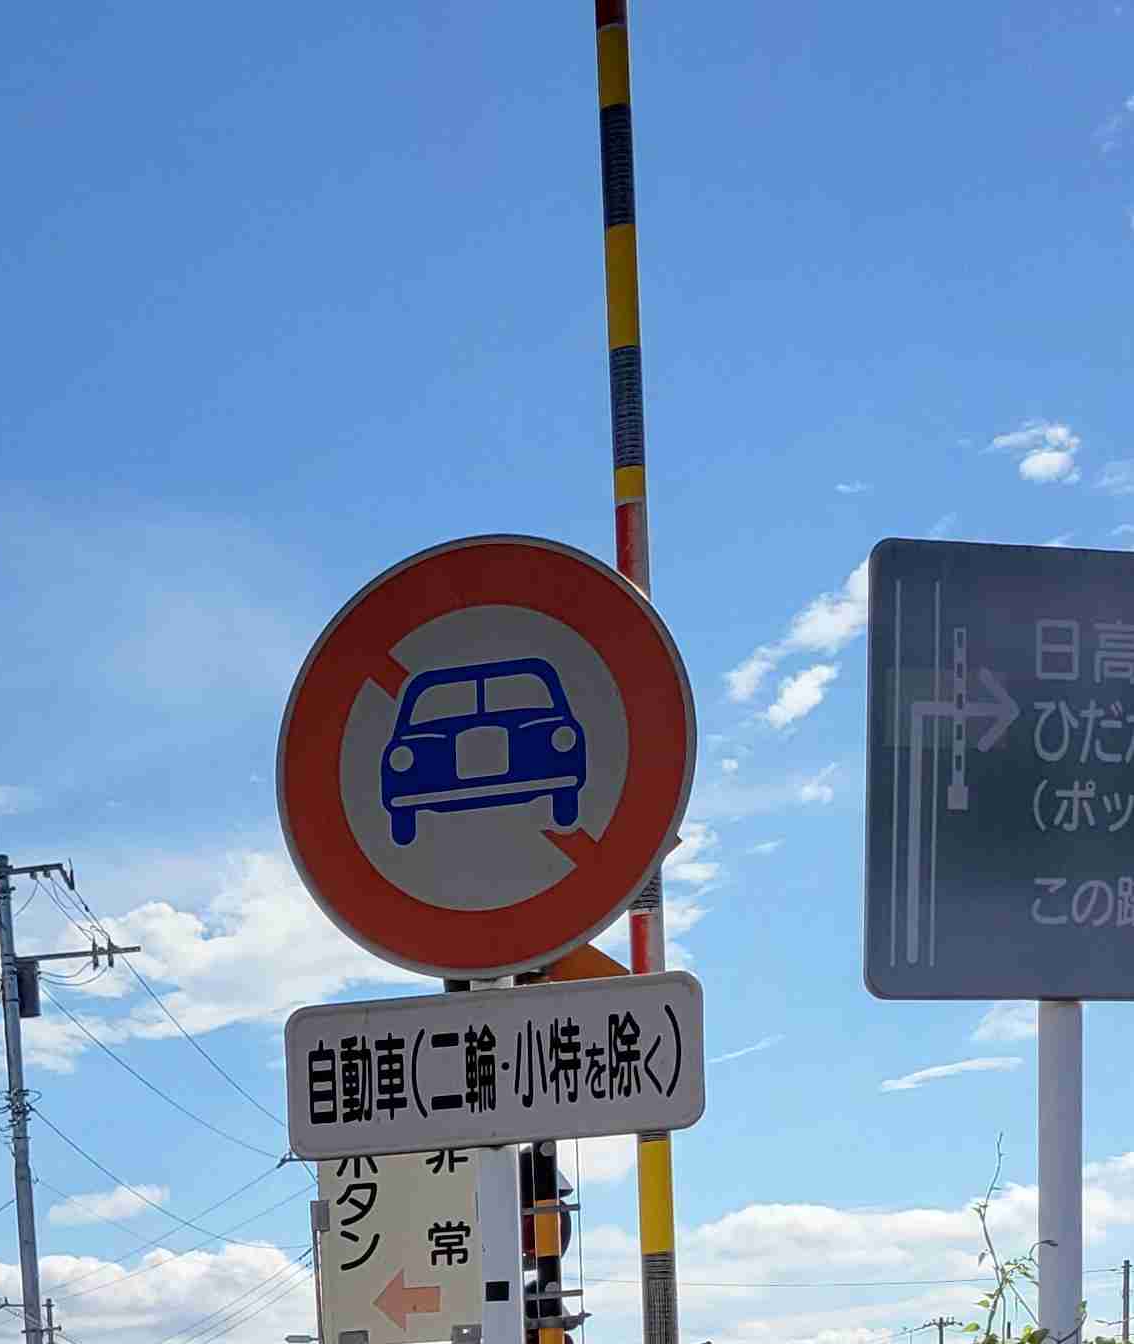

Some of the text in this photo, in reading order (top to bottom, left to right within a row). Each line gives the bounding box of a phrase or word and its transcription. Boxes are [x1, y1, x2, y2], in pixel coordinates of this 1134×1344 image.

[1034, 619, 1134, 683] 日高
[1033, 700, 1134, 764] ひだ
[1033, 779, 1134, 832] (ポッ
